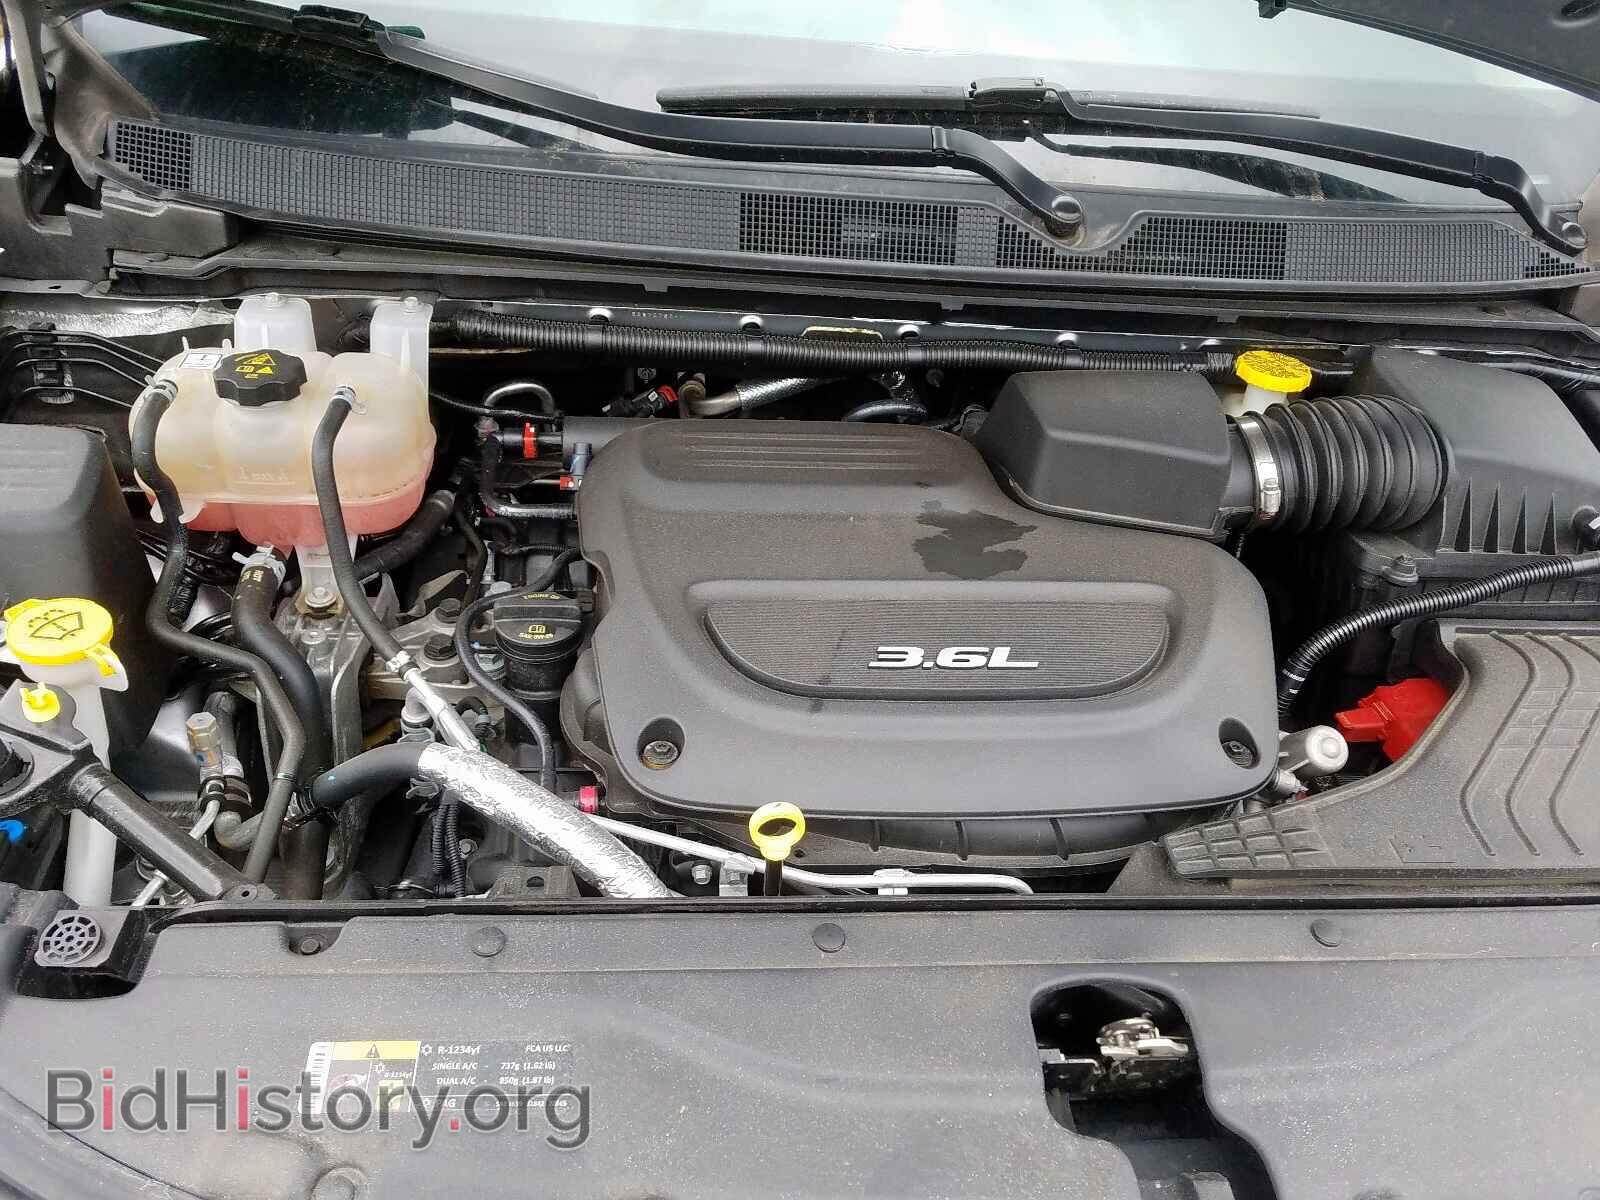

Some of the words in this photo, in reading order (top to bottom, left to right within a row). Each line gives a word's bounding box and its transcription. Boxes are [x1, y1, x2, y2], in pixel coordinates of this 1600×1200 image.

[867, 646, 1040, 669] 3.6L
[437, 1044, 481, 1056] R-1234yf
[526, 1044, 541, 1053] FCA
[542, 1044, 554, 1053] US
[555, 1044, 570, 1053] LLC
[432, 1062, 461, 1071] SINGLE
[462, 1061, 479, 1071] A/C
[500, 1062, 520, 1071] 737g
[436, 1076, 458, 1085] DUAL
[460, 1075, 477, 1085] A/C
